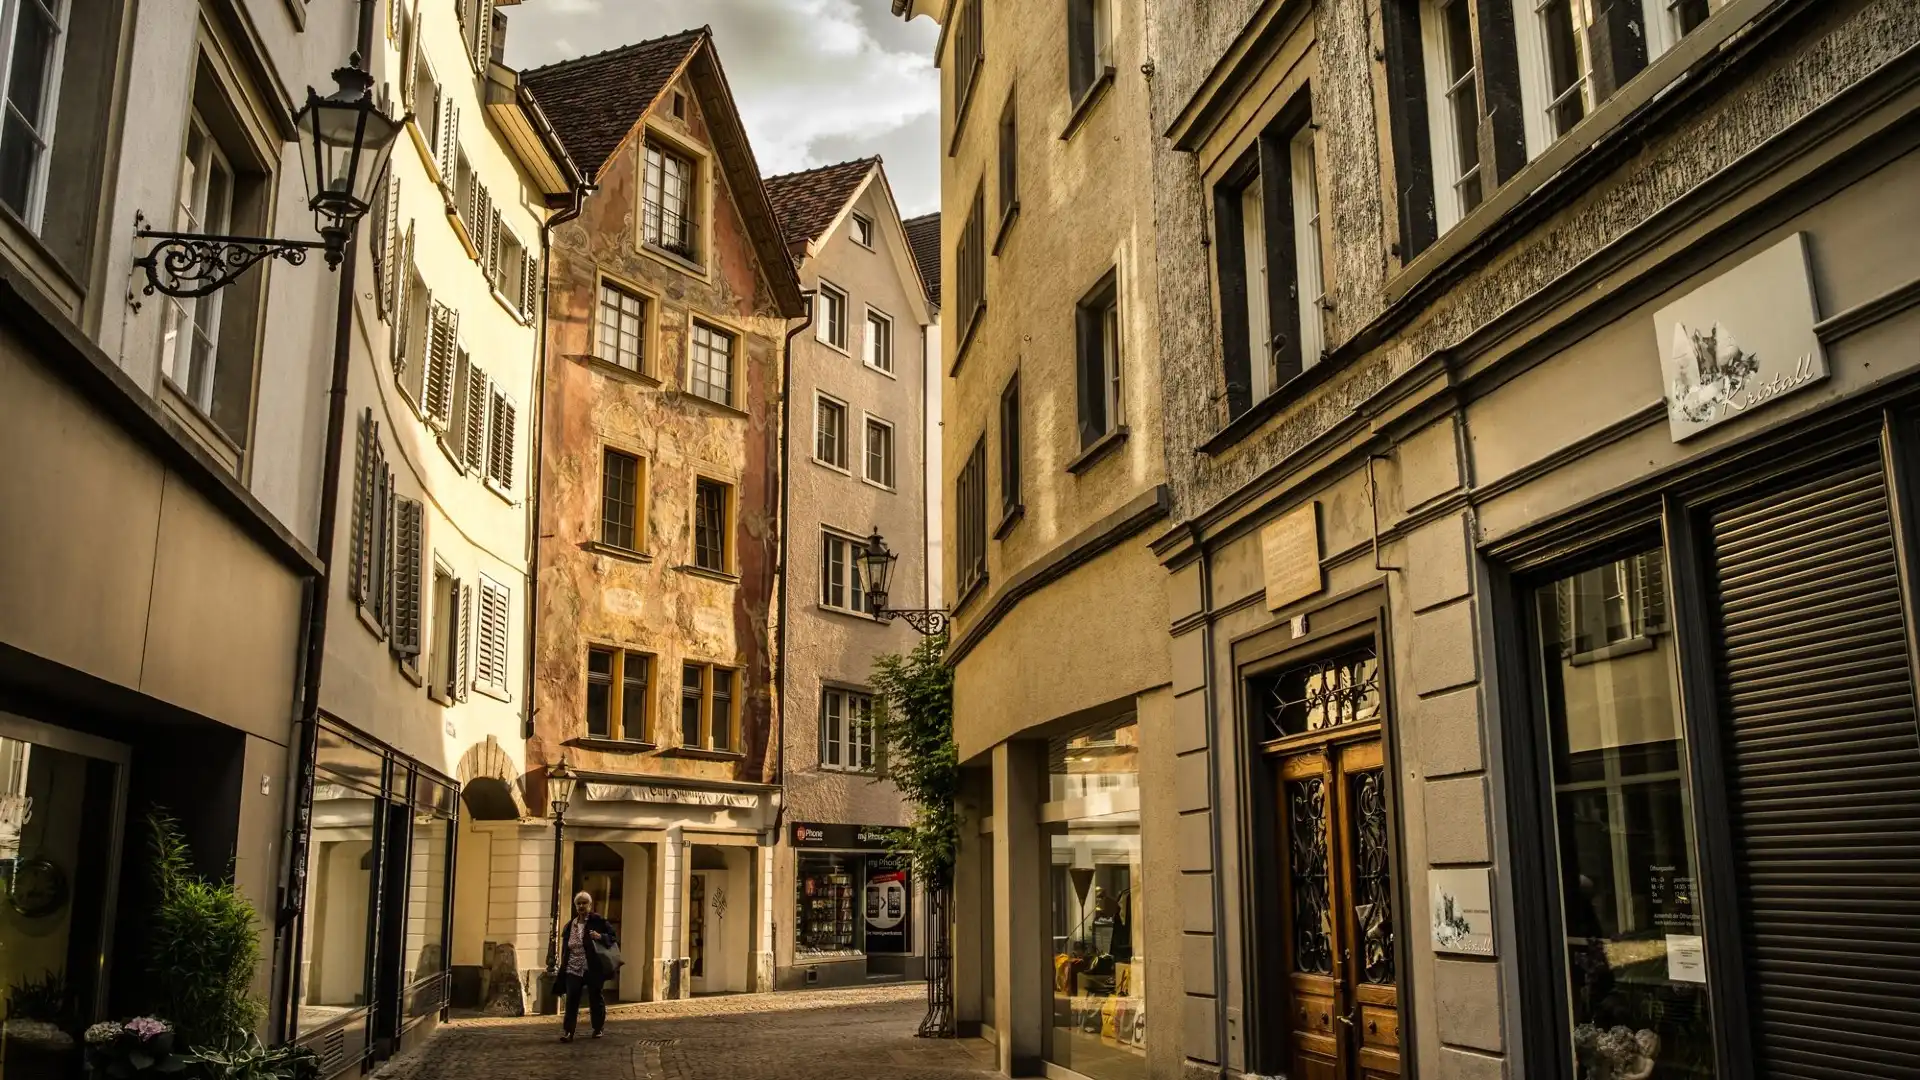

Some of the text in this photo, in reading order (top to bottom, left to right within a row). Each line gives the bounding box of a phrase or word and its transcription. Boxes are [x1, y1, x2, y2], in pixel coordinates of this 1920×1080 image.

[1721, 352, 1815, 416] Kristall
[805, 828, 824, 838] Phone
[857, 832, 867, 842] my
